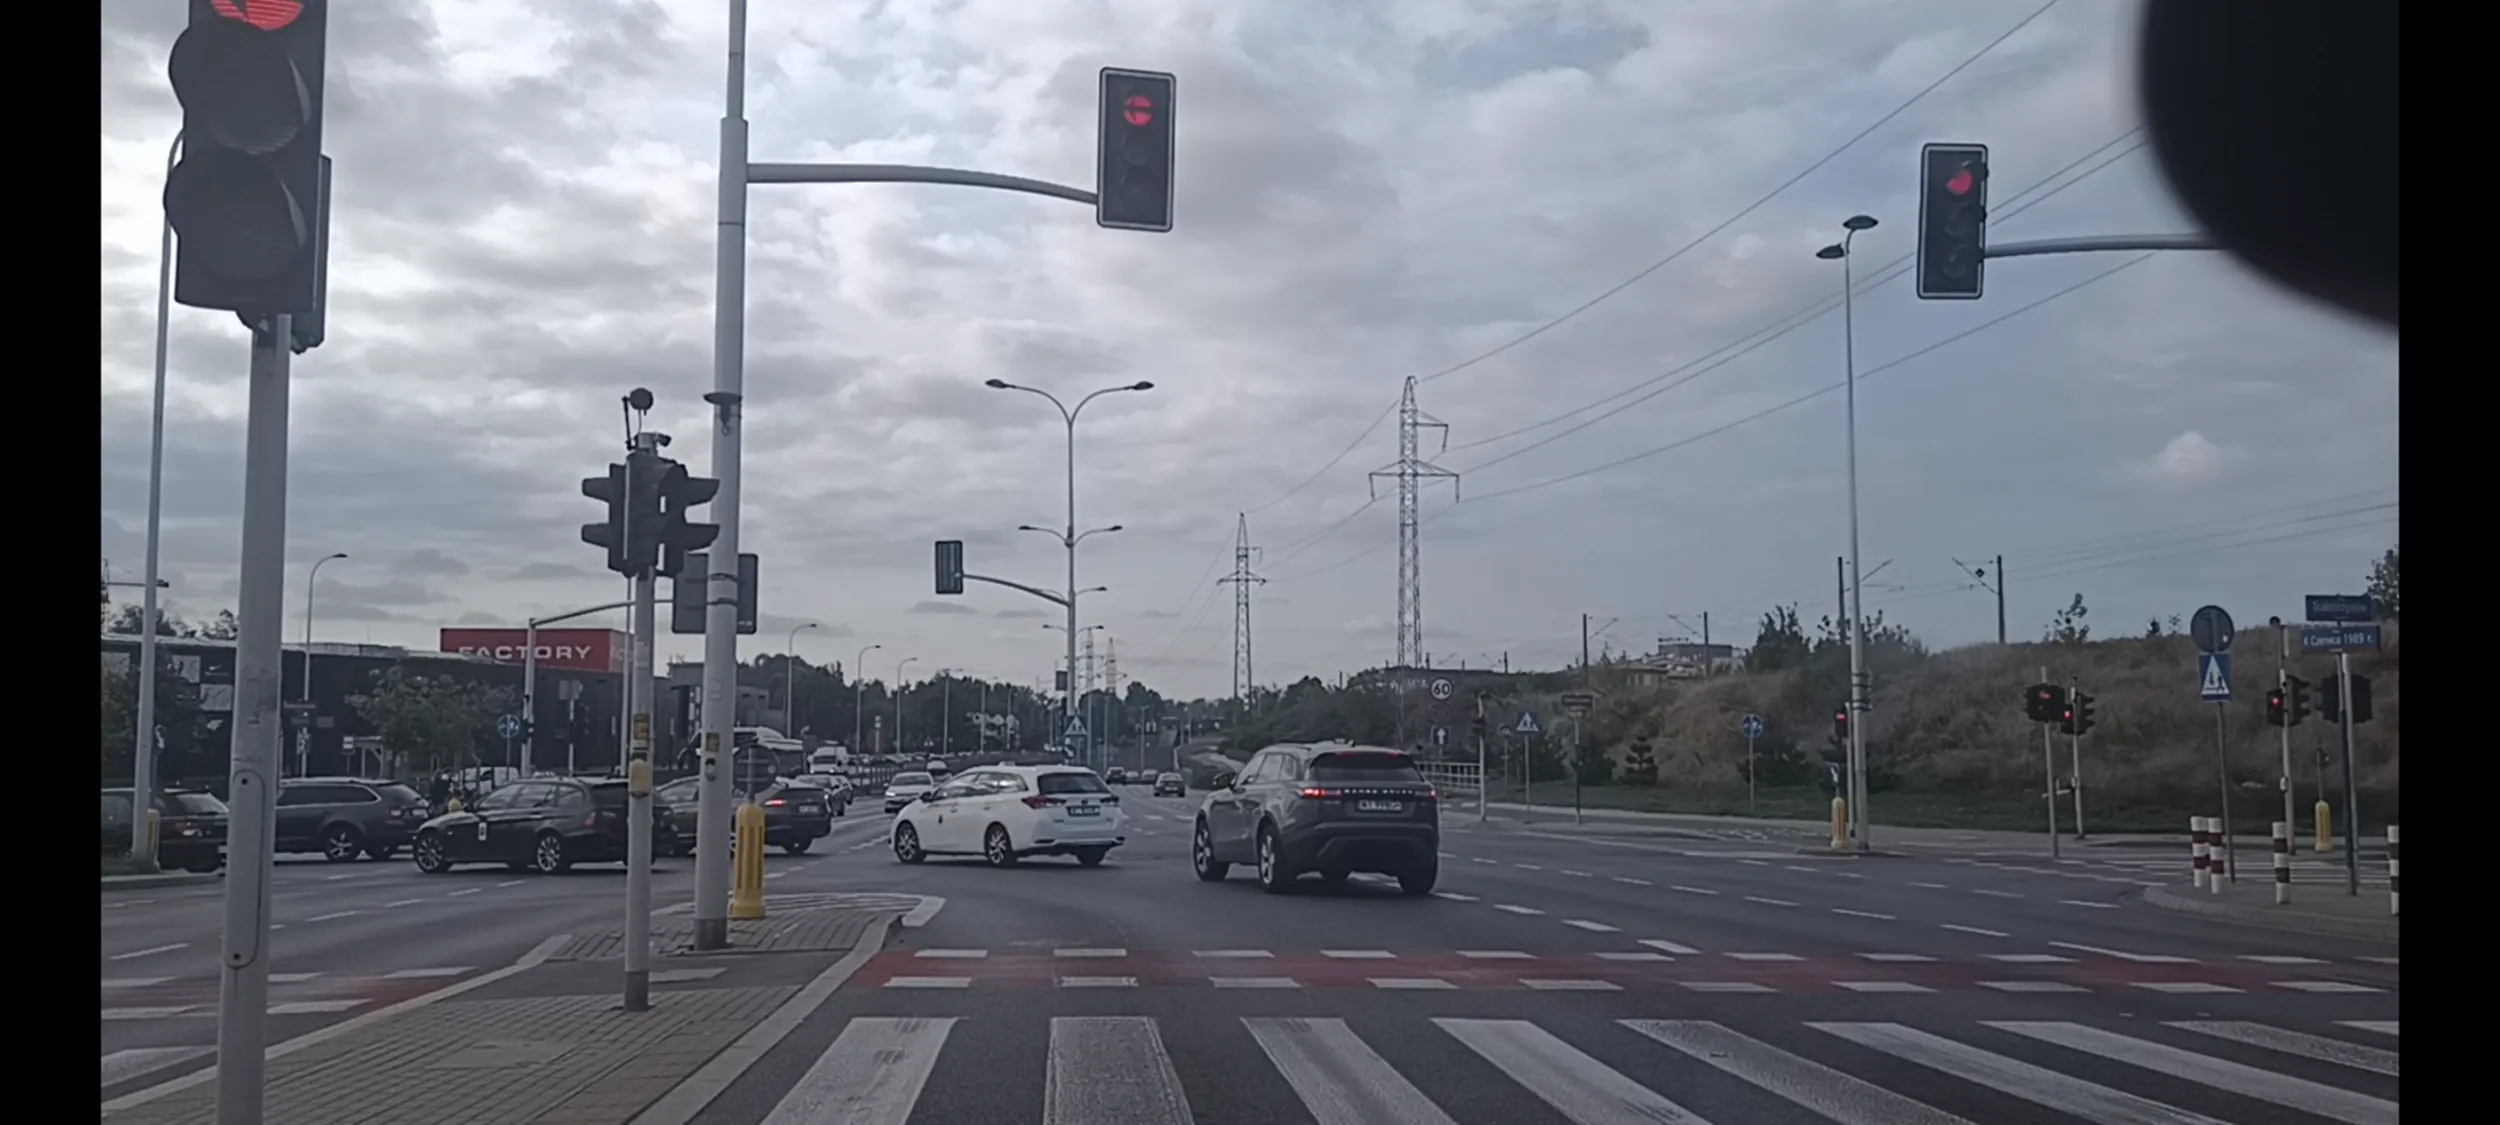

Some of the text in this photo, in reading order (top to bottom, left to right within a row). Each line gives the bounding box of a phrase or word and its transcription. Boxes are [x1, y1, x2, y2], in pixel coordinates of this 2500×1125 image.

[2343, 633, 2364, 645] 1989
[458, 645, 592, 660] FACTORY
[1433, 683, 1450, 695] 60
